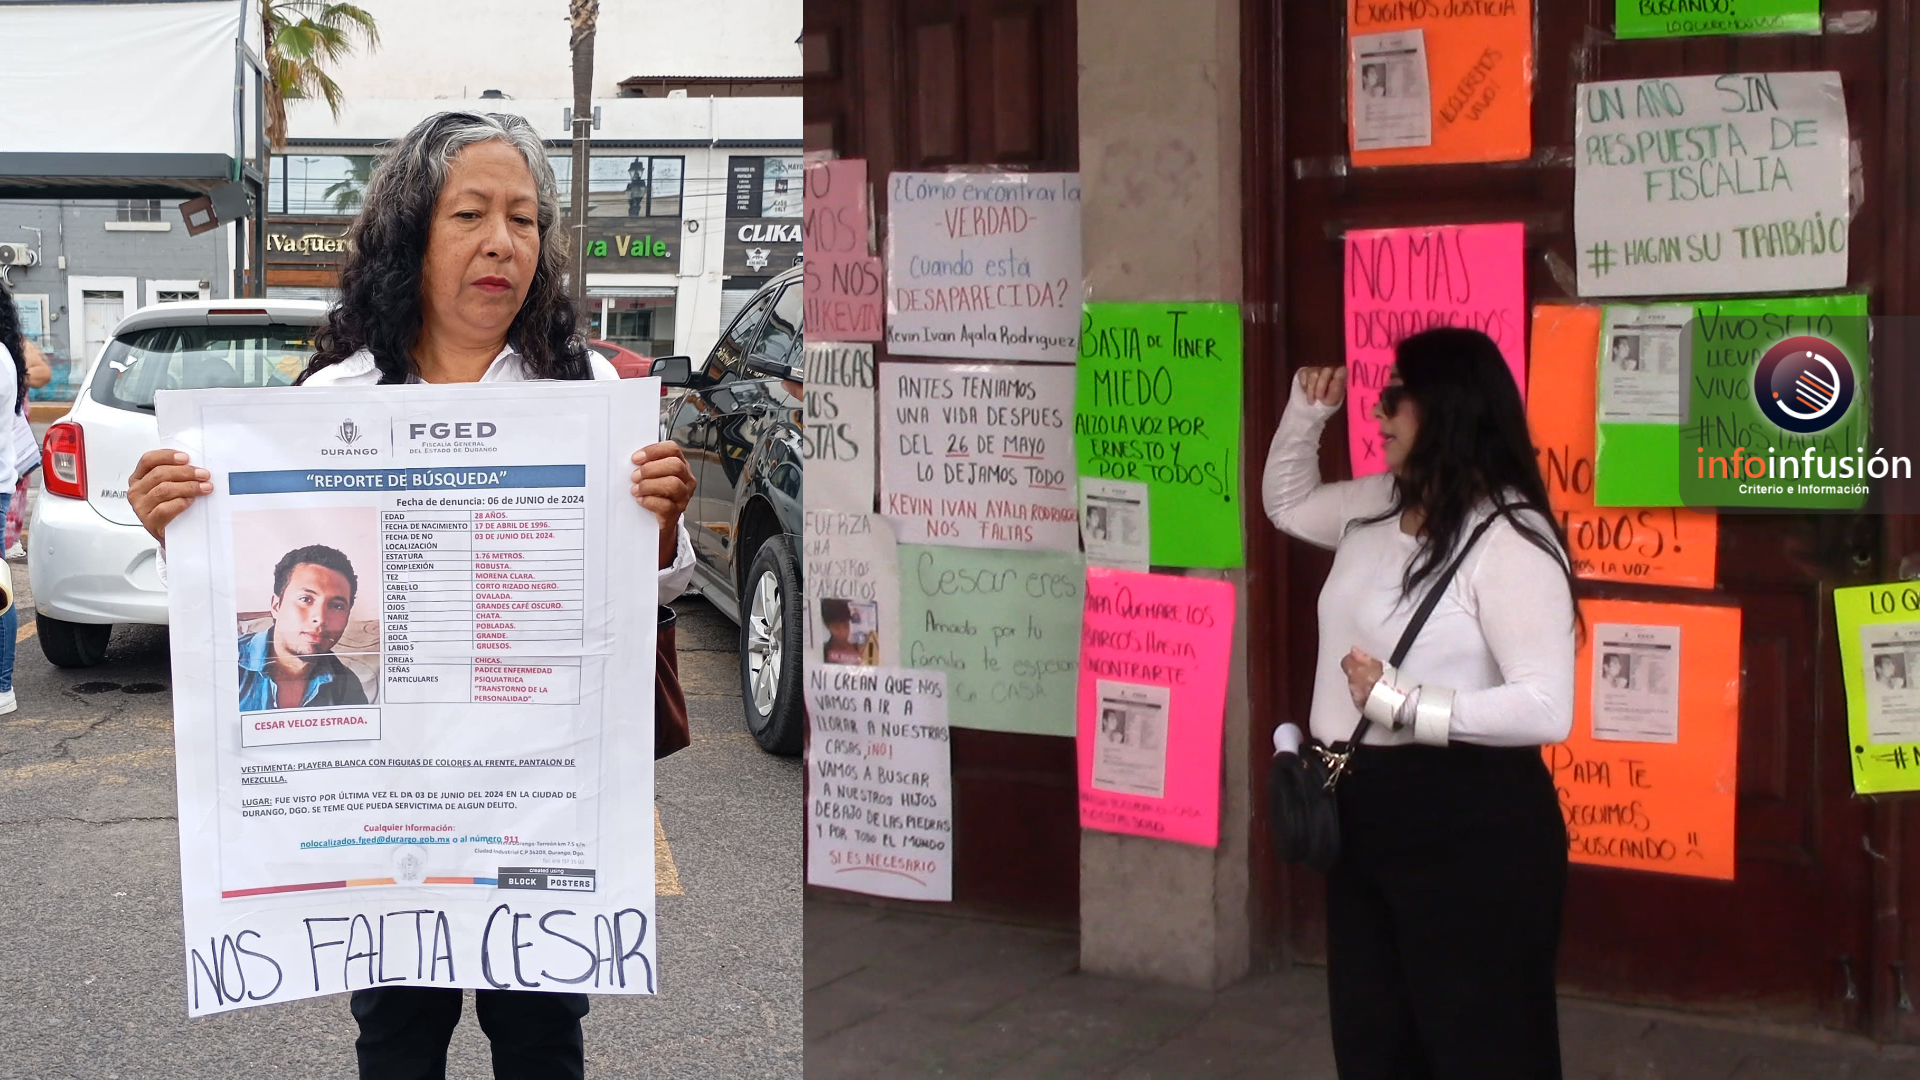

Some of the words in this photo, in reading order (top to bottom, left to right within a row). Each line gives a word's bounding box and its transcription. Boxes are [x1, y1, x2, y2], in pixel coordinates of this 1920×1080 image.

[1354, 0, 1439, 26] EXIGIMOS
[1443, 0, 1516, 18] JUSTICIA
[1586, 86, 1625, 124] UN
[1636, 79, 1685, 118] AÑO
[1714, 73, 1778, 113] SIN
[1585, 122, 1748, 166] RESPUESTA
[1770, 117, 1818, 151] DE
[1644, 155, 1794, 203] FISCALIA
[738, 224, 803, 242] CLIKA
[832, 261, 879, 296] NOS
[1351, 236, 1396, 302] NO
[1408, 229, 1470, 304] MAS
[896, 278, 1068, 312] DESAPARECIDA?
[887, 325, 920, 343] Kevin
[923, 326, 955, 342] Ivan
[961, 325, 997, 350] Ayala
[1080, 311, 1142, 362] BASTA
[1166, 311, 1223, 362] TENER
[898, 375, 953, 400] ANTES
[961, 376, 1036, 401] TENIAMOS
[1093, 365, 1173, 407] MIEDO
[1695, 375, 1751, 401] VIVO
[896, 407, 929, 425] UNA
[942, 407, 977, 425] VIDA
[987, 407, 1063, 428] DESPUES
[1131, 416, 1164, 436] VOZ
[1168, 416, 1209, 440] POR
[409, 422, 497, 439] FGED
[321, 448, 378, 456] DURANGO
[899, 434, 934, 455] DEL
[947, 435, 969, 454] 26
[977, 435, 995, 454] DE
[1003, 435, 1045, 456] MAYO
[1091, 438, 1165, 462] ERNESTO
[1171, 441, 1181, 467] Y
[388, 474, 408, 487] DE
[917, 462, 934, 483] LO
[944, 463, 1017, 485] DEJAMOS
[1028, 466, 1065, 487] TODO
[1088, 457, 1140, 481] POR
[396, 498, 424, 507] Fecha
[425, 498, 438, 506] de
[439, 497, 485, 506] denuncia:
[487, 496, 499, 505] 06
[501, 496, 513, 505] de
[514, 495, 545, 505] JUNIO
[547, 495, 559, 504] de
[561, 495, 585, 504] 2024
[889, 494, 932, 516] KEVIN
[941, 495, 977, 517] IVAN
[986, 496, 1027, 520] AYALA
[421, 522, 468, 530] NACIMIENTO
[484, 511, 508, 519] AÑOS.
[926, 520, 959, 538] NOS
[980, 521, 1033, 543] FALTAS
[386, 562, 434, 570] COMPLEXIÓN
[917, 551, 1017, 597] Cesar
[1025, 570, 1076, 598] eres
[1601, 561, 1617, 573] LA
[511, 601, 529, 609] CAFÉ
[1869, 590, 1895, 615] LO
[810, 670, 827, 692] NI
[834, 672, 878, 692] CREAN
[885, 675, 913, 695] QUE
[918, 679, 942, 698] NOS
[254, 720, 285, 731] CESAR
[287, 718, 318, 728] VELOZ
[320, 716, 367, 727] ESTRADA.
[817, 760, 858, 780] VAMOS
[863, 766, 872, 781] A
[878, 766, 929, 788] BUSCAR
[1545, 742, 1611, 788] PAPA
[1619, 758, 1652, 788] TE
[823, 782, 831, 797] A
[837, 785, 893, 806] NUESTROS
[901, 792, 937, 808] HIJOS
[1556, 786, 1650, 832] SEGUIMOS
[363, 824, 403, 833] Cualquier
[460, 835, 467, 843] al
[469, 835, 502, 844] número
[503, 835, 519, 844] 911
[1567, 830, 1676, 861] BUSCANDO
[829, 850, 841, 865] SI
[847, 851, 861, 865] ES
[866, 853, 936, 873] NECESARIO
[508, 877, 537, 886] BLOCK
[550, 879, 590, 888] POSTERS
[191, 929, 282, 1009] NOS
[303, 909, 456, 991] FALTA
[481, 904, 654, 994] CESAR
